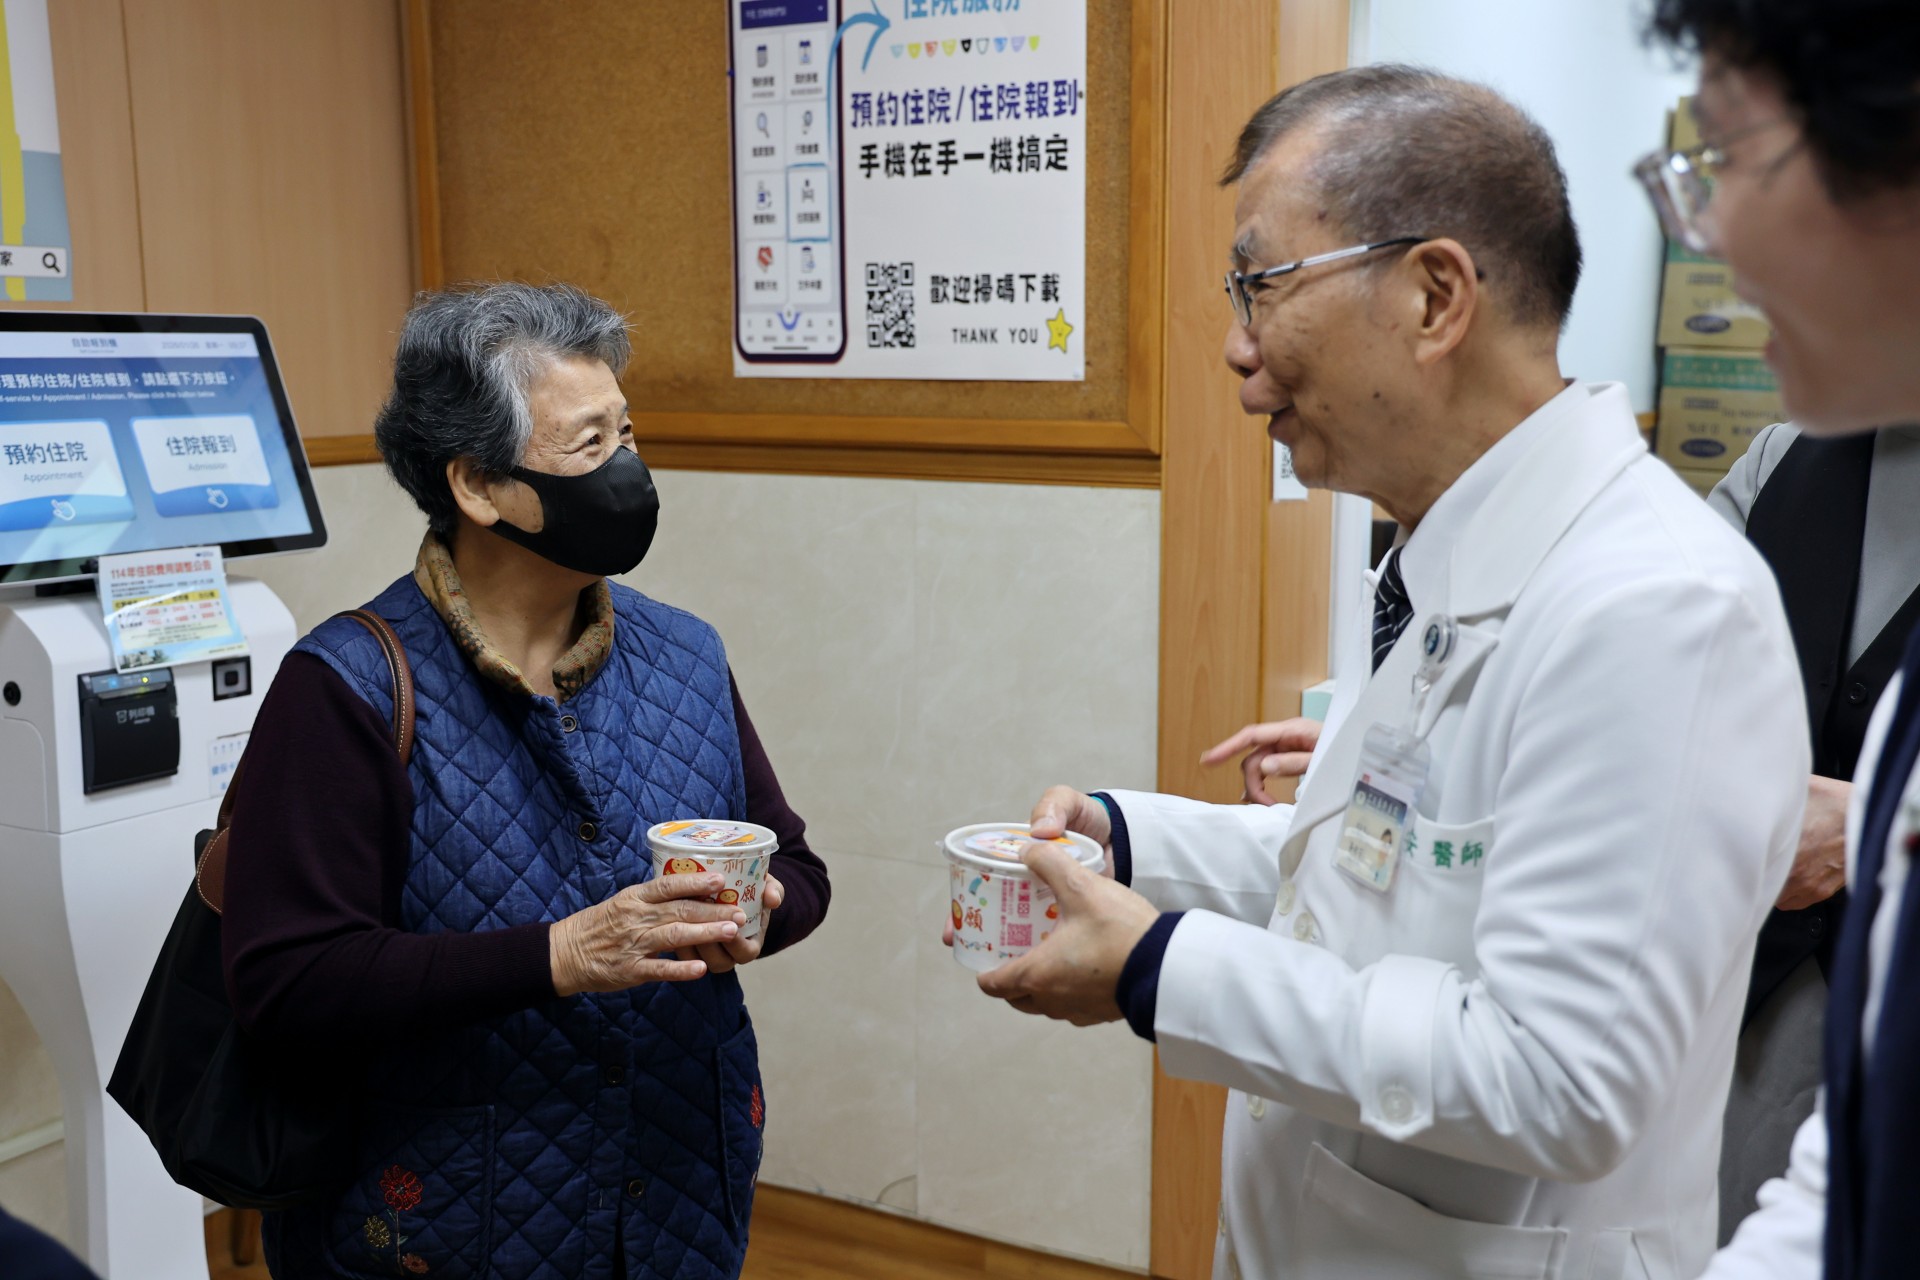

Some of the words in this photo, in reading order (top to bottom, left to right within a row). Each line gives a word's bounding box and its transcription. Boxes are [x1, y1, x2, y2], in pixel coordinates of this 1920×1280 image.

[851, 80, 1078, 128] 預約住院/住院報到
[859, 135, 1069, 178] 手機在手一機搞定
[930, 274, 1060, 305] 歡迎掃碼下載
[952, 328, 998, 343] THANK
[1009, 328, 1038, 343] YOU
[43, 393, 86, 402] Appointment
[4, 442, 88, 466] 預約住院
[166, 435, 237, 457] 住院報到
[23, 471, 84, 483] Appointment
[188, 462, 229, 472] Admission
[1432, 840, 1483, 868] 醫師
